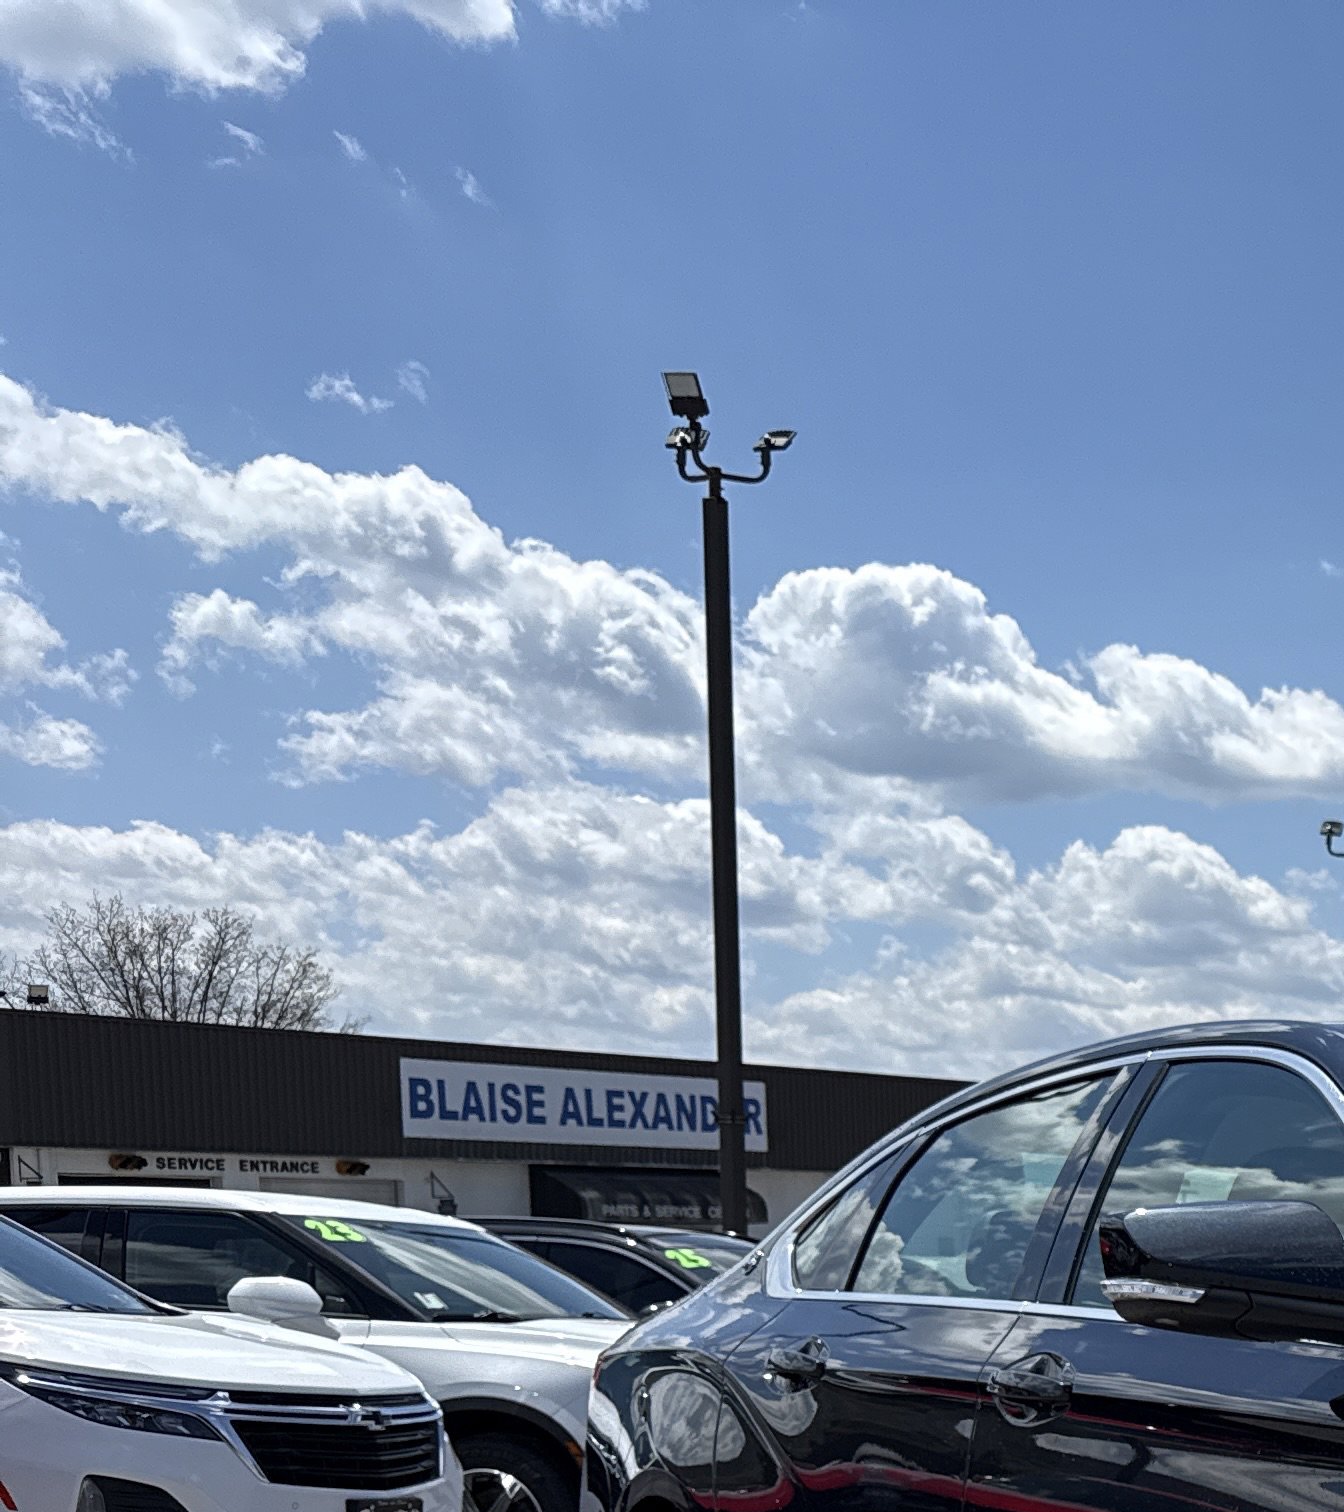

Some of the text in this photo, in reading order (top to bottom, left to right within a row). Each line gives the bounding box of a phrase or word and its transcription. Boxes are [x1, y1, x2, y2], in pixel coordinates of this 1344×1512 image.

[408, 1077, 764, 1136] BLAISE ALEXANDR
[156, 1157, 320, 1174] SERVICE ENTRANCE
[601, 1203, 640, 1219] PARTS
[643, 1204, 652, 1219] &
[655, 1204, 702, 1219] SERVICE
[304, 1218, 368, 1243] 23
